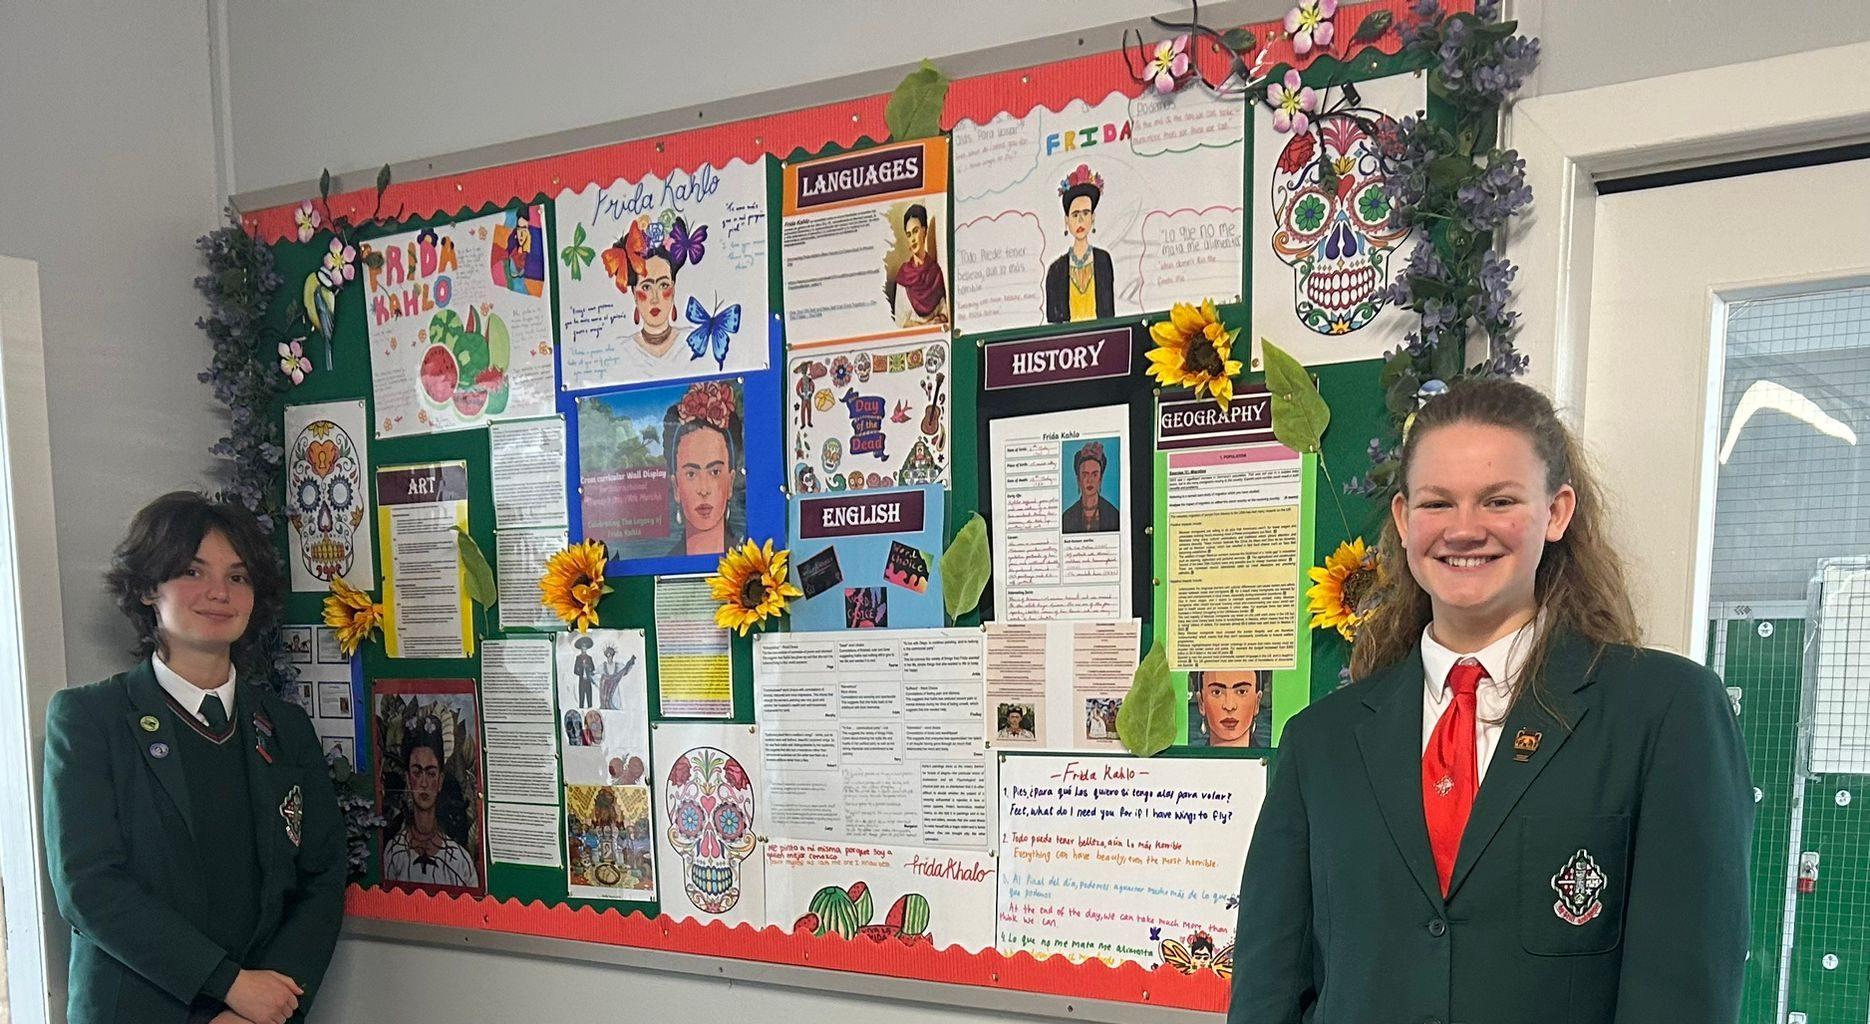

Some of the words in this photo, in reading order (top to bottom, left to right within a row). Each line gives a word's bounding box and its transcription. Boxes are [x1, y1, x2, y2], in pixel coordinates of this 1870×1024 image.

[1046, 120, 1132, 156] FRIDA
[802, 157, 919, 197] LANGUAGES
[661, 162, 721, 212] Kahlo
[373, 275, 453, 327] KAHLO
[1012, 338, 1106, 376] HISTORY
[855, 400, 879, 416] Day
[1161, 400, 1267, 430] GEOGRAPHY
[856, 420, 864, 431] of
[866, 420, 878, 430] the
[852, 434, 882, 451] Dead
[1042, 432, 1060, 441] Frida
[1060, 431, 1080, 440] Kahlo
[626, 470, 641, 480] Wall
[643, 469, 666, 480] Display
[408, 476, 436, 495] ART
[822, 502, 900, 528] ENGLISH
[1104, 764, 1135, 780] Kahlo
[1176, 790, 1198, 805] para
[1202, 790, 1232, 804] volar?
[1030, 806, 1054, 816] what
[1056, 806, 1068, 816] do
[1077, 806, 1096, 817] need
[1100, 809, 1115, 820] you
[1153, 808, 1172, 819] have
[1199, 810, 1208, 819] to
[1212, 810, 1233, 824] fly?
[845, 847, 870, 857] porque
[1014, 847, 1051, 863] Everything
[1146, 855, 1158, 865] the
[1023, 904, 1035, 914] the
[1040, 905, 1053, 915] end
[1057, 906, 1065, 916] of
[1069, 907, 1080, 917] the
[1120, 913, 1134, 921] can
[1208, 923, 1228, 934] than
[1022, 934, 1035, 947] que
